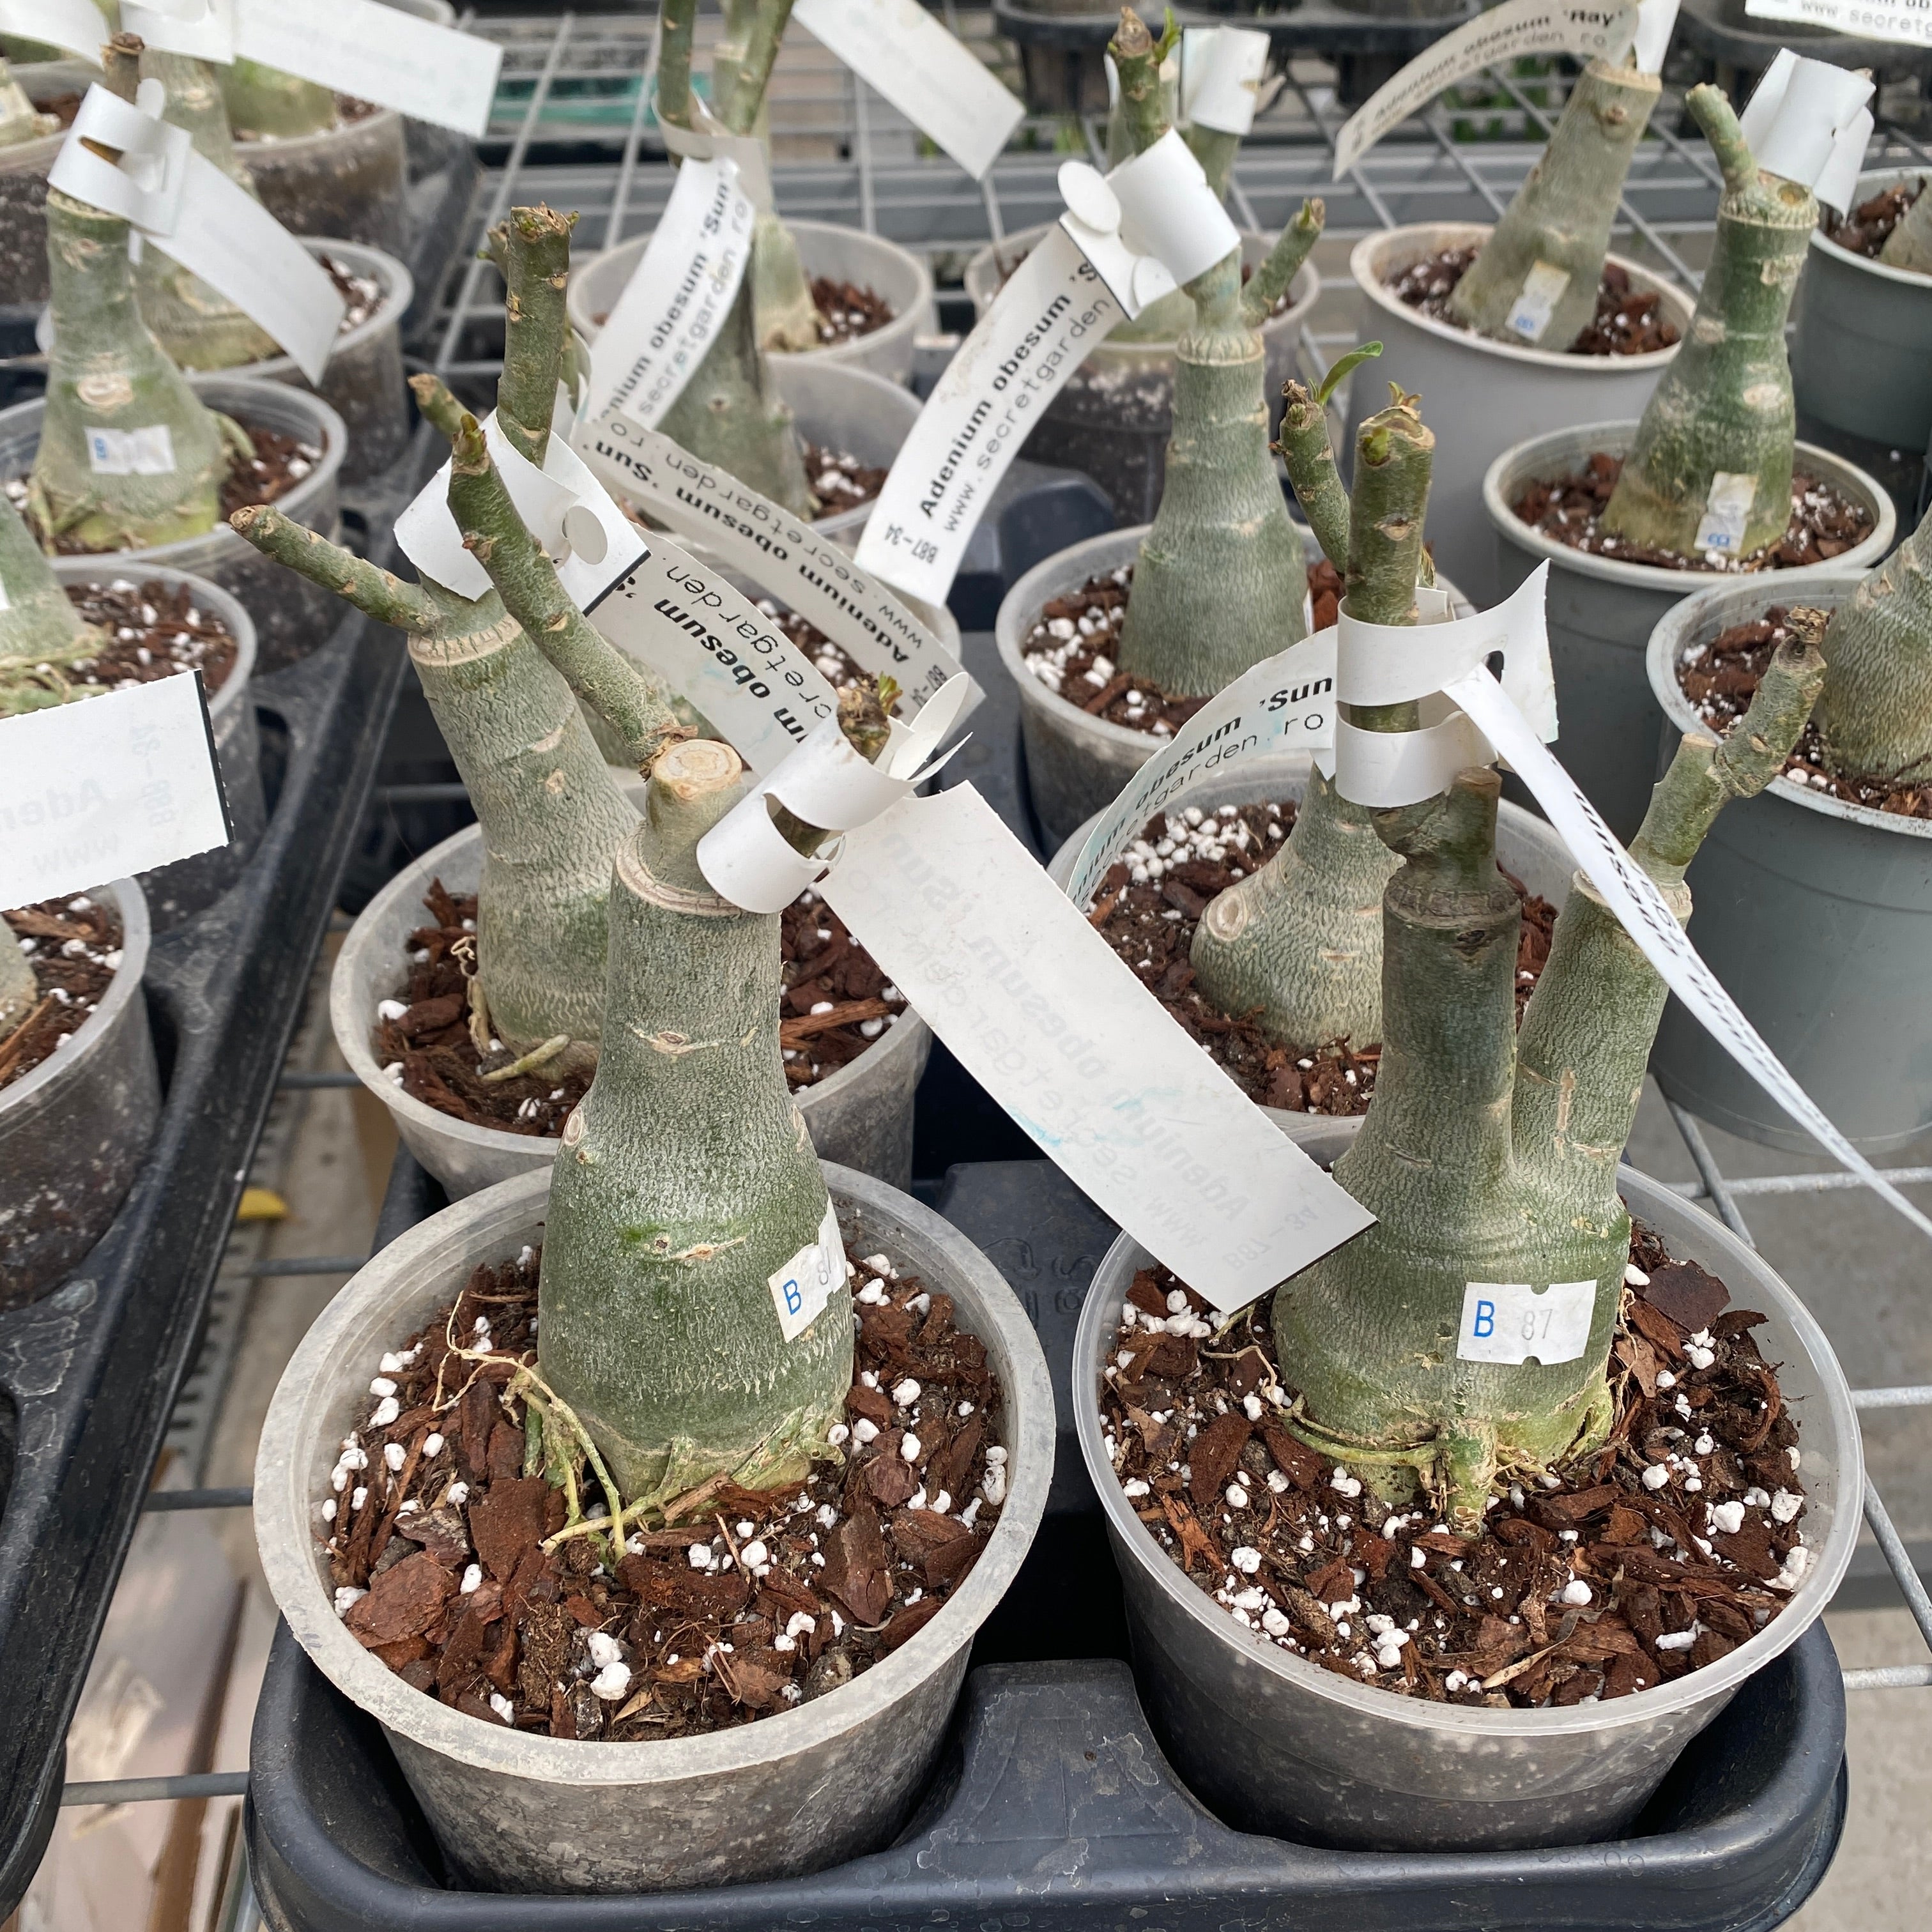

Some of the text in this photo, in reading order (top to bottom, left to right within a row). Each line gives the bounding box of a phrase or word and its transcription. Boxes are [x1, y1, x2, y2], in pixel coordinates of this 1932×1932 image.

[650, 252, 707, 349] obesum
[920, 399, 993, 519] Adenium
[992, 294, 1071, 391] obesum
[675, 487, 788, 562] obesum
[654, 599, 770, 698] obesum
[799, 563, 910, 664] Adenium
[1136, 716, 1241, 810] obesum
[783, 1278, 801, 1315] B
[1473, 1300, 1553, 1341] B 87
